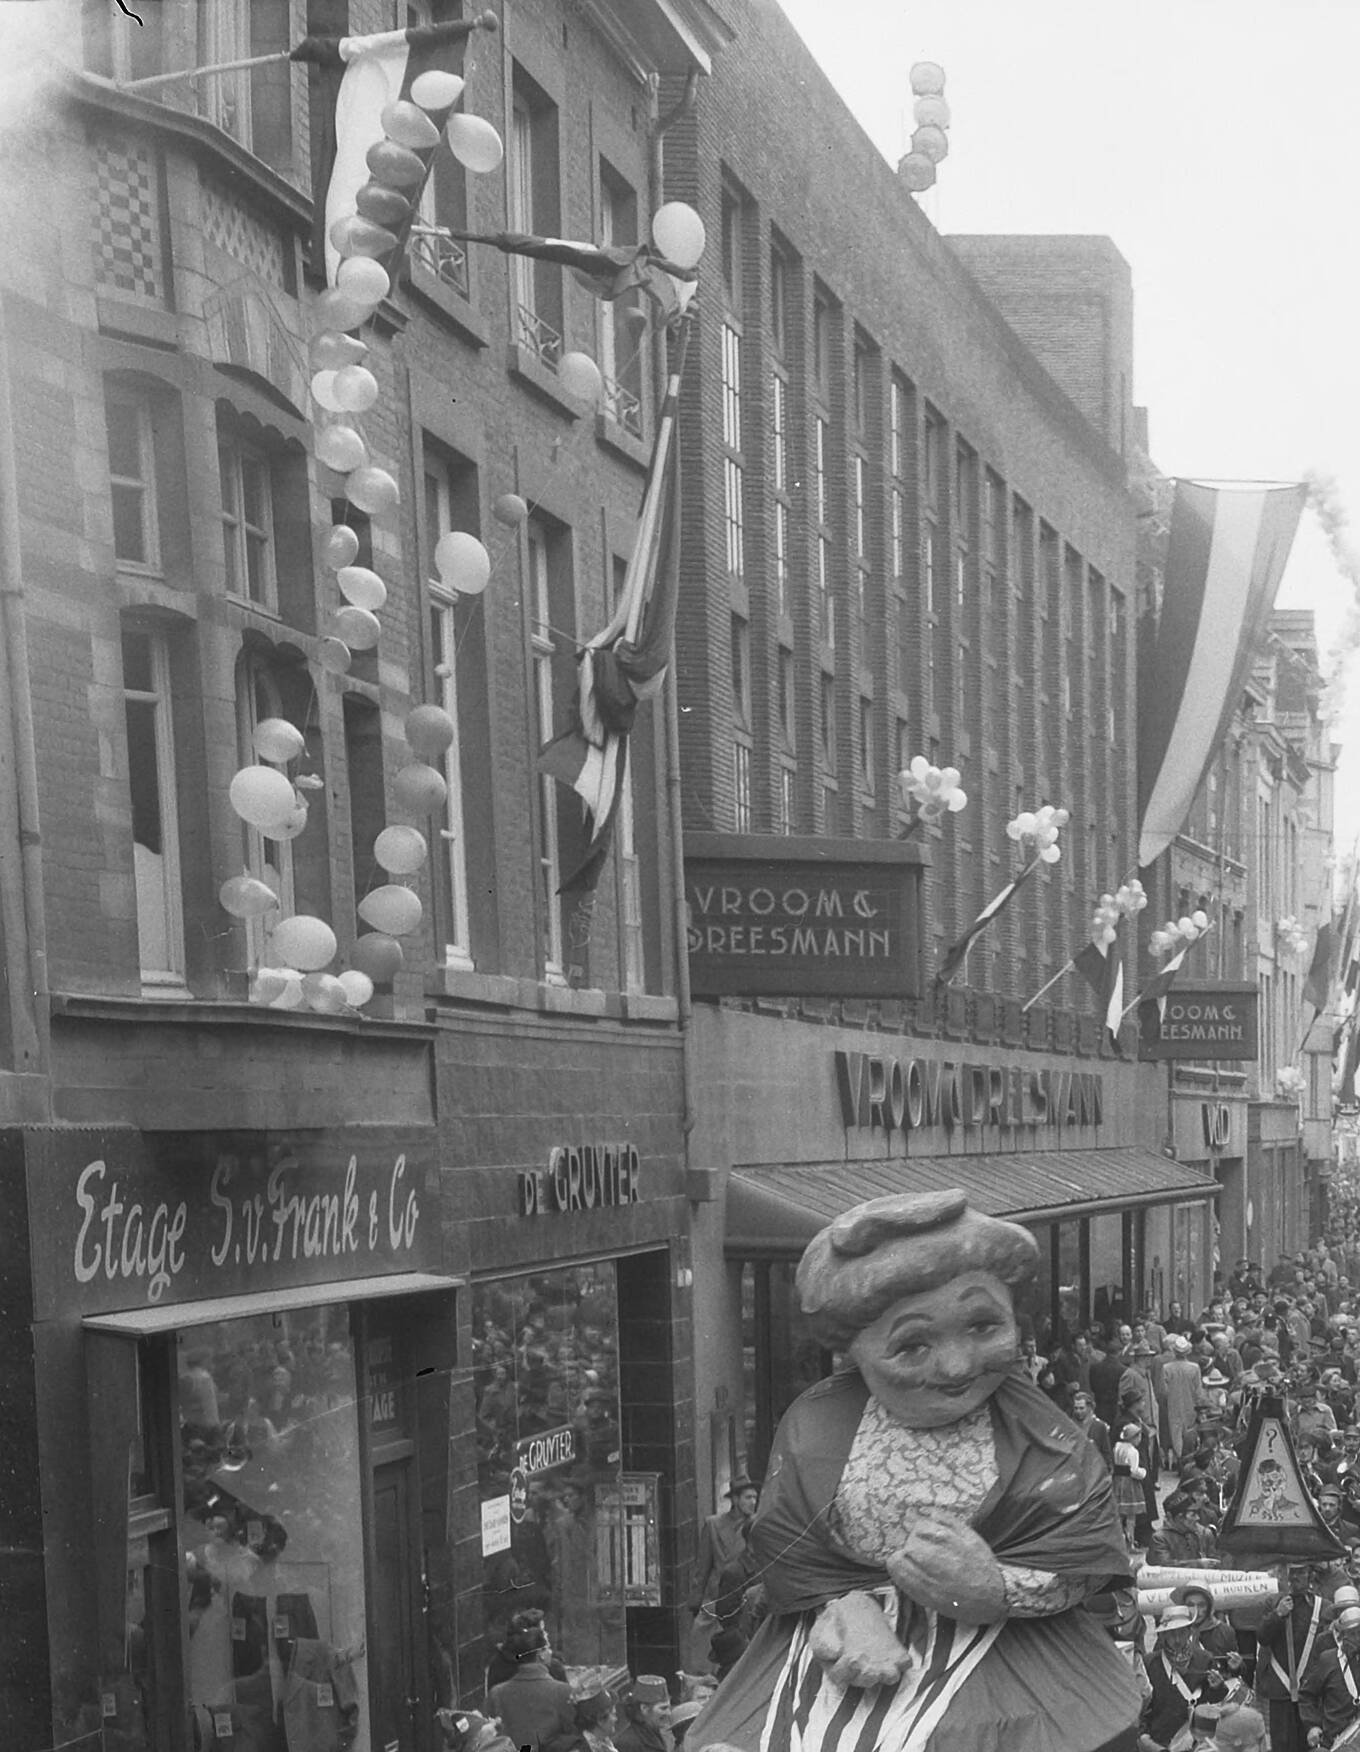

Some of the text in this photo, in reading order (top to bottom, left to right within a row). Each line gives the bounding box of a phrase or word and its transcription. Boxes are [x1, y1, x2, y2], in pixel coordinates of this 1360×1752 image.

[694, 886, 844, 917] VROOM
[686, 926, 891, 957] DREESMANN
[1164, 1004, 1219, 1020] OOM
[1160, 1024, 1243, 1041] EESMANN
[519, 1143, 643, 1217] DE GRUYTER
[74, 1159, 188, 1302] Etage
[389, 1152, 419, 1251] Co
[359, 1391, 396, 1426] TAGE
[519, 1453, 528, 1474] DE
[529, 1430, 572, 1472] GRUYTER
